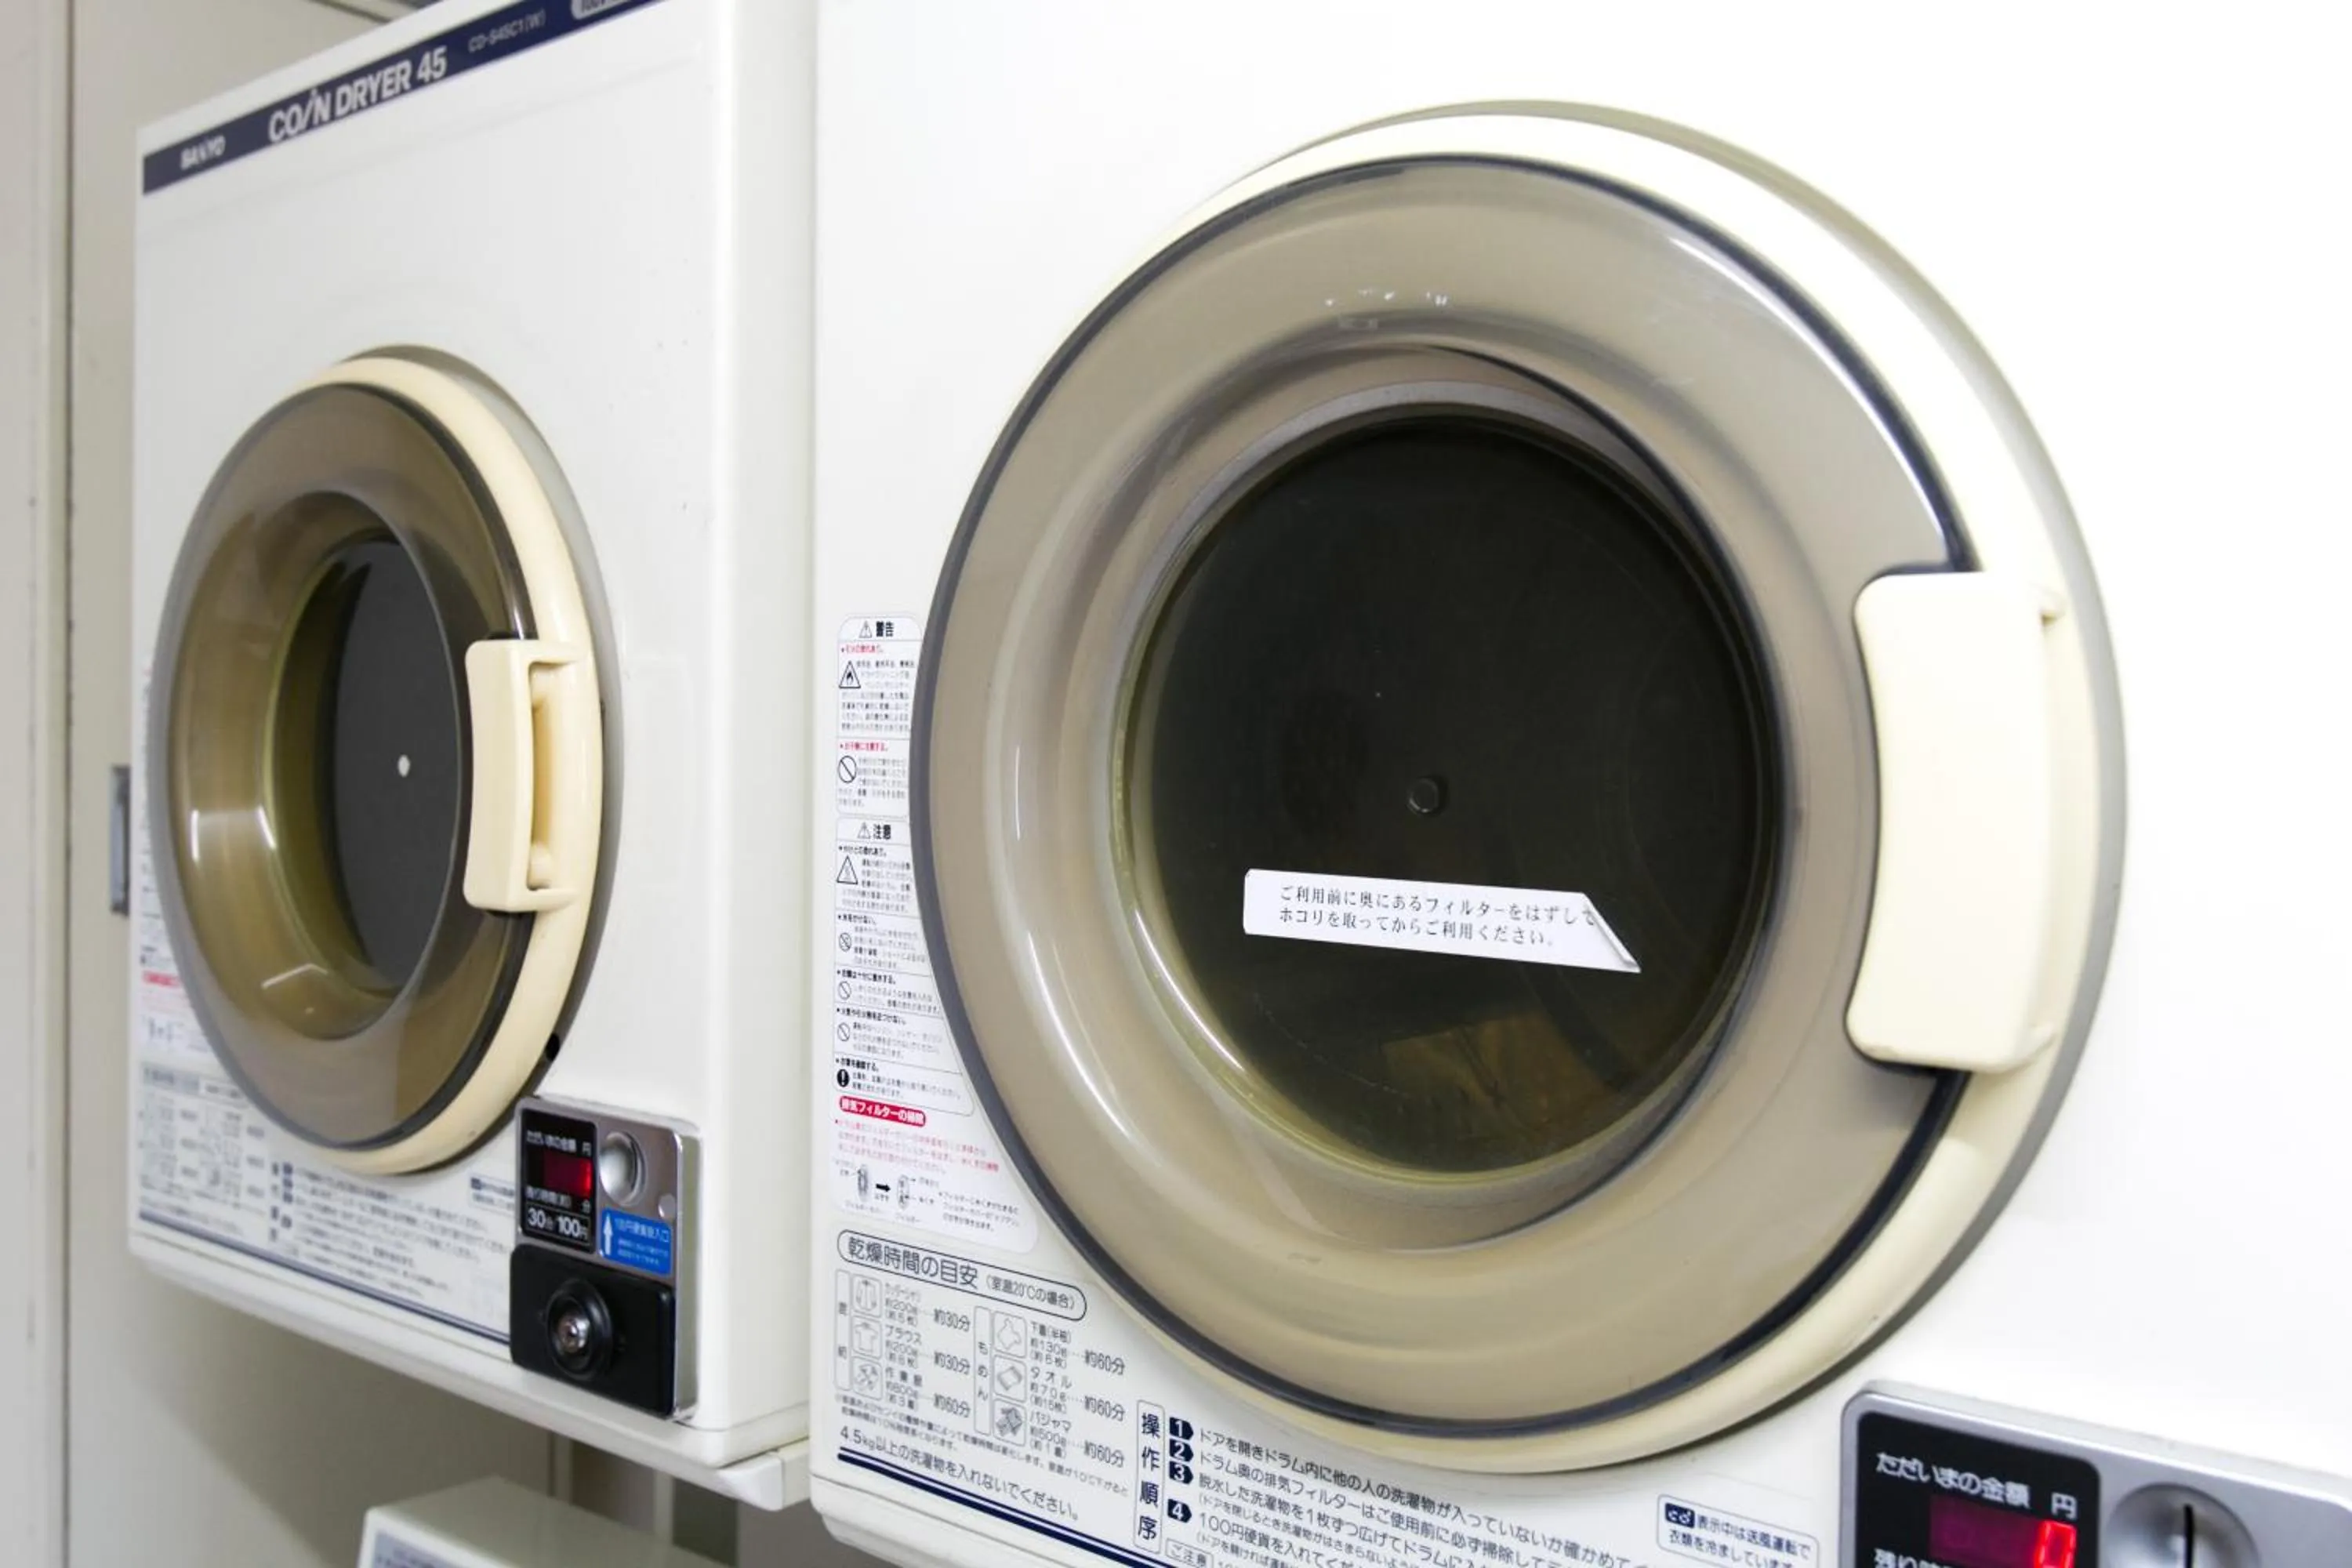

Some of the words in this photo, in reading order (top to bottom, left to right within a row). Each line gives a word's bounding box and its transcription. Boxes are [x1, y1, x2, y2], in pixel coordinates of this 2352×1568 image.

[335, 59, 412, 117] DRYER
[417, 45, 448, 82] 45
[873, 824, 891, 840] 注意
[1279, 885, 1594, 926] ご利用前に奥にあるフィルターをはずして
[1279, 906, 1553, 946] ホコリを取ってからご利用ください。
[848, 1236, 978, 1289] 乾燥時間の目安
[1138, 1412, 1160, 1541] 操作順序
[1200, 1427, 1650, 1568] ドアを開きドラム内に他の人の洗濯物が入っていないか確かめて
[1876, 1452, 2031, 1509] ただいまの金額
[2051, 1491, 2078, 1519] 円
[1200, 1473, 1486, 1568] 脱水した洗濯物を1枚ずつ広げてドラムに
